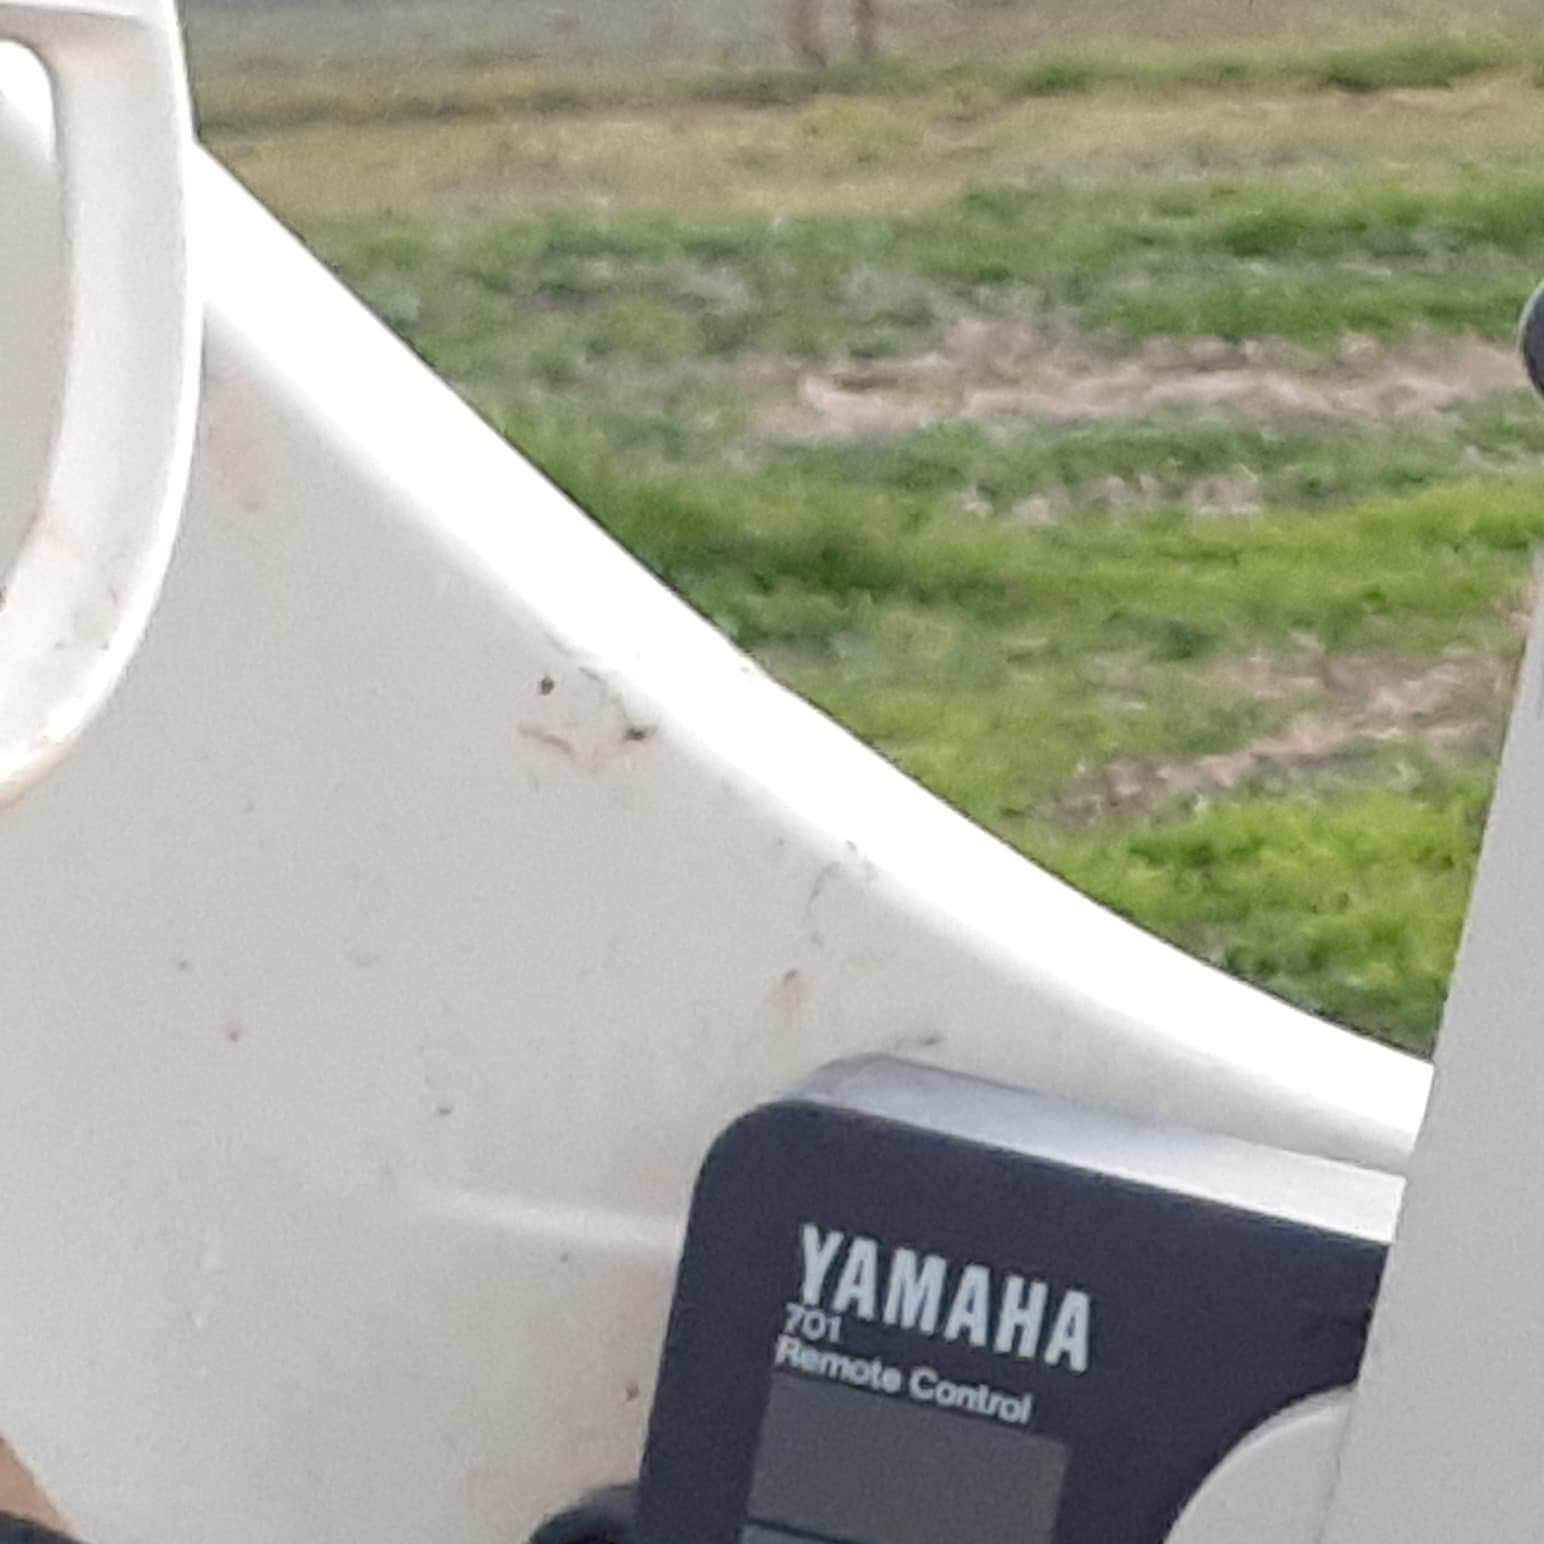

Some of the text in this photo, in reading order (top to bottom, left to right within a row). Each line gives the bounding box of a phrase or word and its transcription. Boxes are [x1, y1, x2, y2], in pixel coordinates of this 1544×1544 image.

[785, 1302, 841, 1342] 701
[801, 1223, 1092, 1373] YAMAHA
[774, 1335, 1033, 1425] Remote Control
